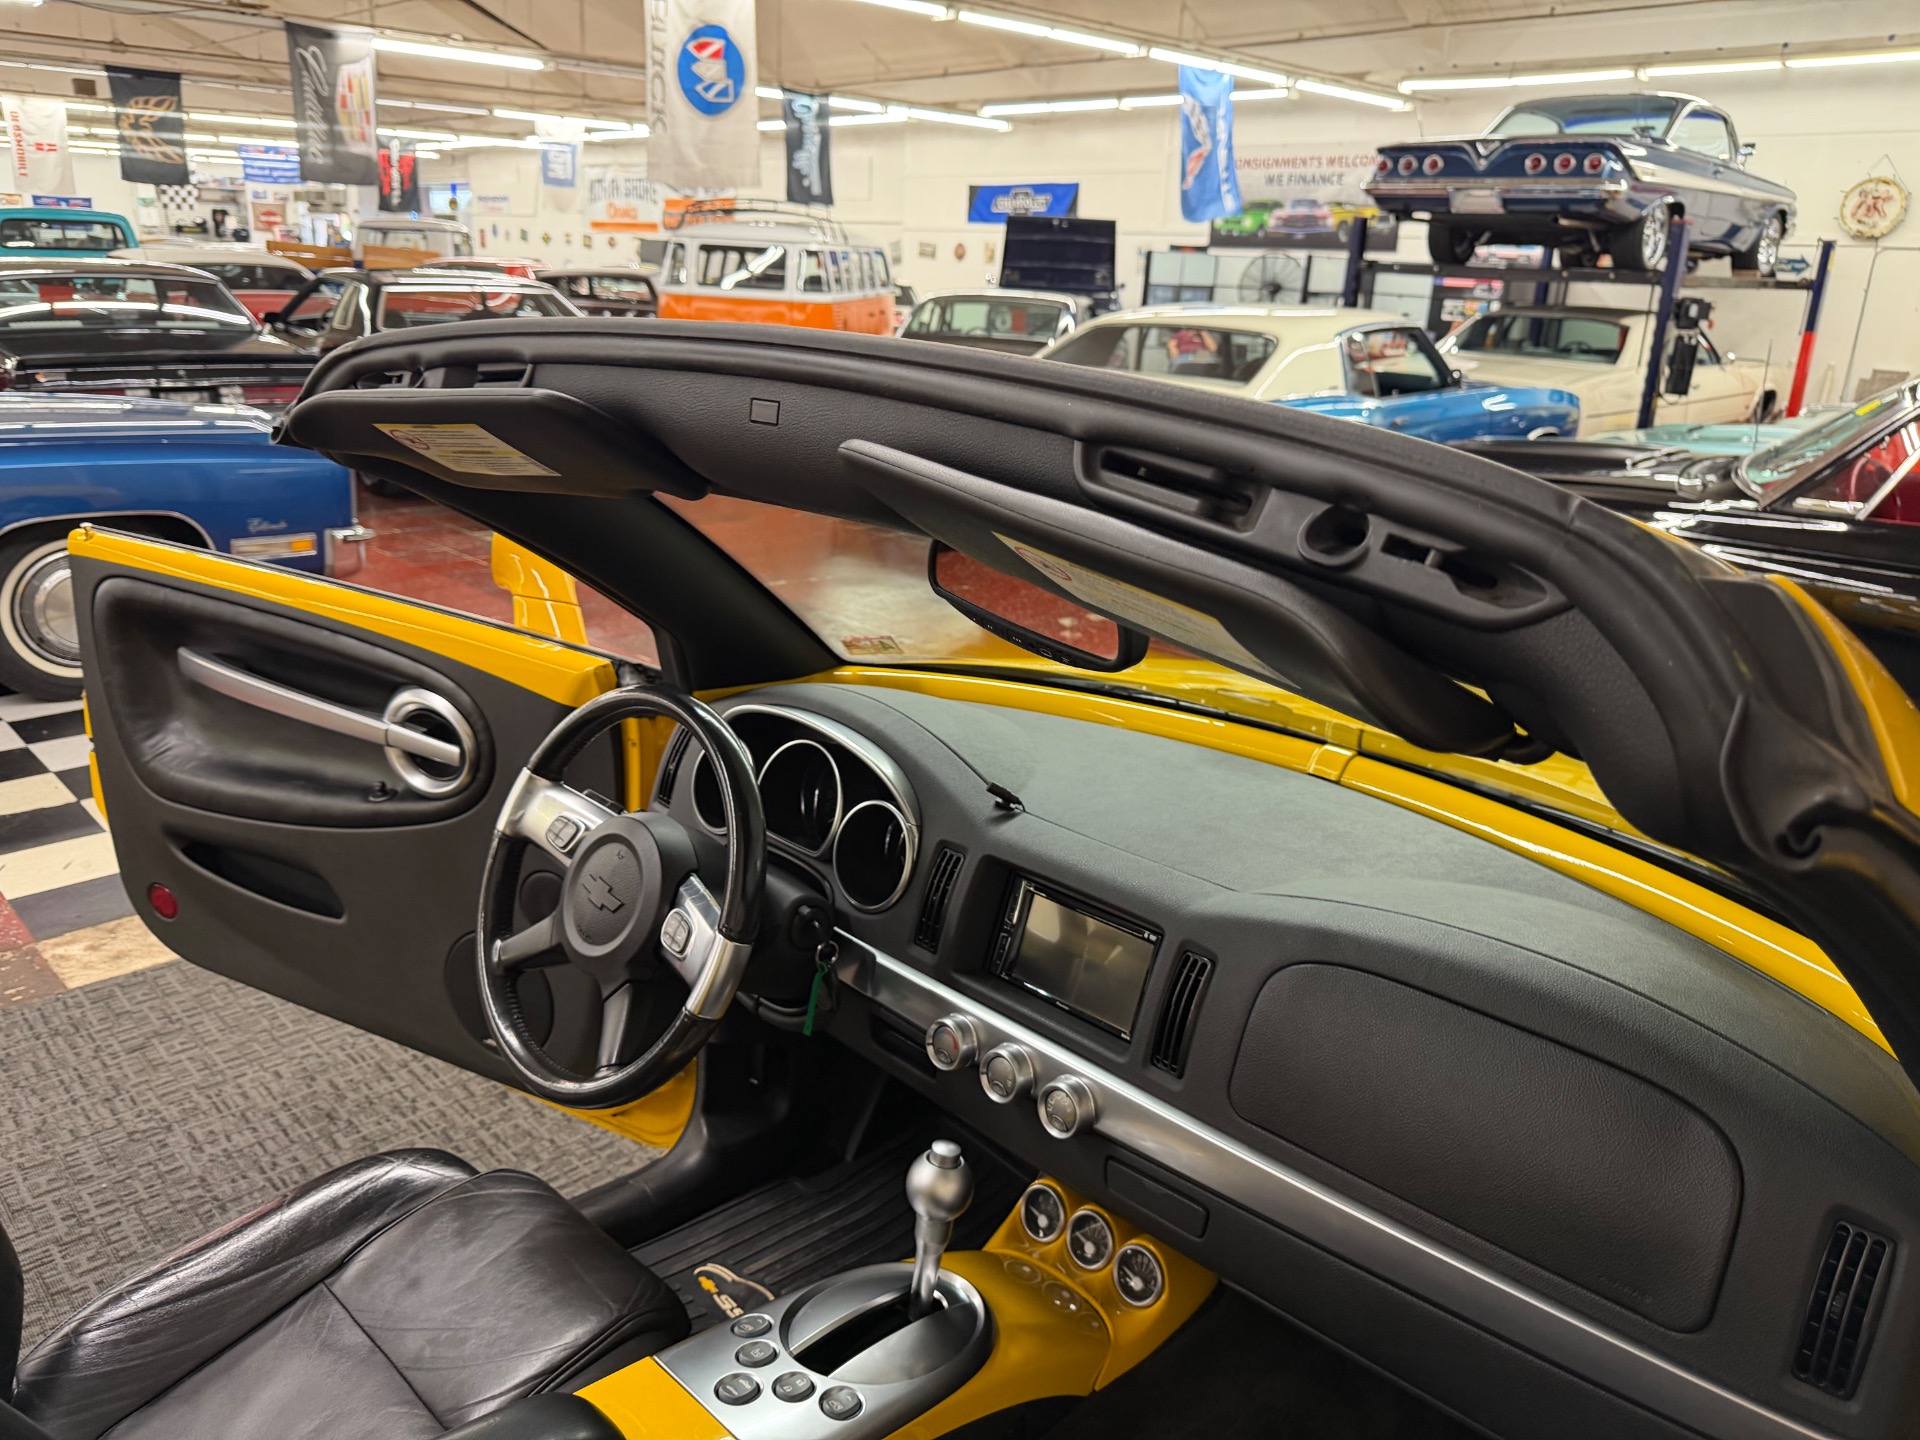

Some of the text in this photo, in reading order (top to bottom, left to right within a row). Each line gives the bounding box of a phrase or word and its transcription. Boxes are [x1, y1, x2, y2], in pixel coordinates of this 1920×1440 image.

[651, 0, 668, 135] BUICK
[295, 44, 329, 164] Cadillac
[1234, 154, 1379, 170] ONSIGNMENTS WELCOM
[1265, 172, 1344, 187] WE FINANCE
